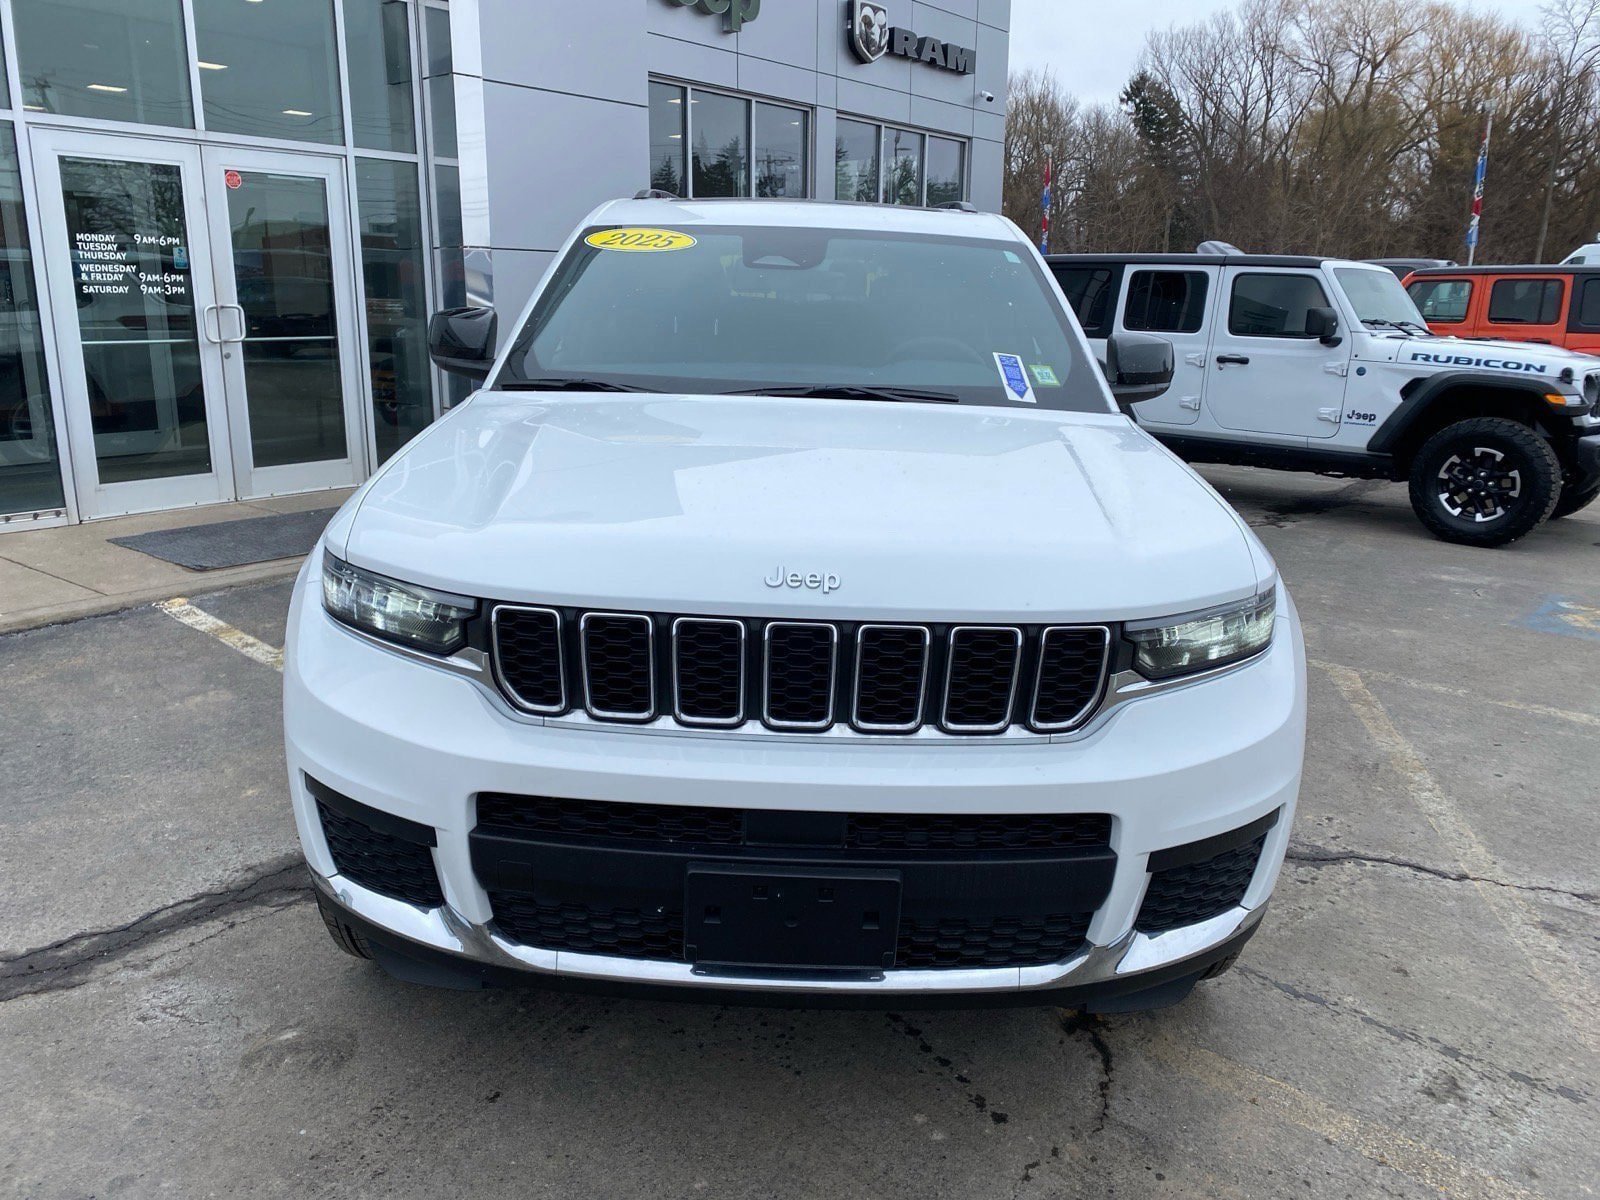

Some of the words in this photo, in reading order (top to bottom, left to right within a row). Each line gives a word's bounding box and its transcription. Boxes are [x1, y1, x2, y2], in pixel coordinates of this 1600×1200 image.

[890, 26, 976, 75] RAM
[76, 233, 115, 243] MONDAY
[600, 232, 681, 248] 2025
[76, 242, 118, 251] TUESDAY
[78, 251, 127, 260] THURSDAY
[80, 264, 136, 273] WEDNESDAY
[81, 272, 89, 281] &
[91, 273, 124, 281] FRIDAY
[82, 285, 129, 294] SATURDAY
[1411, 353, 1546, 373] RUBICON
[1346, 409, 1377, 422] Jeep
[764, 563, 841, 594] Jeep
